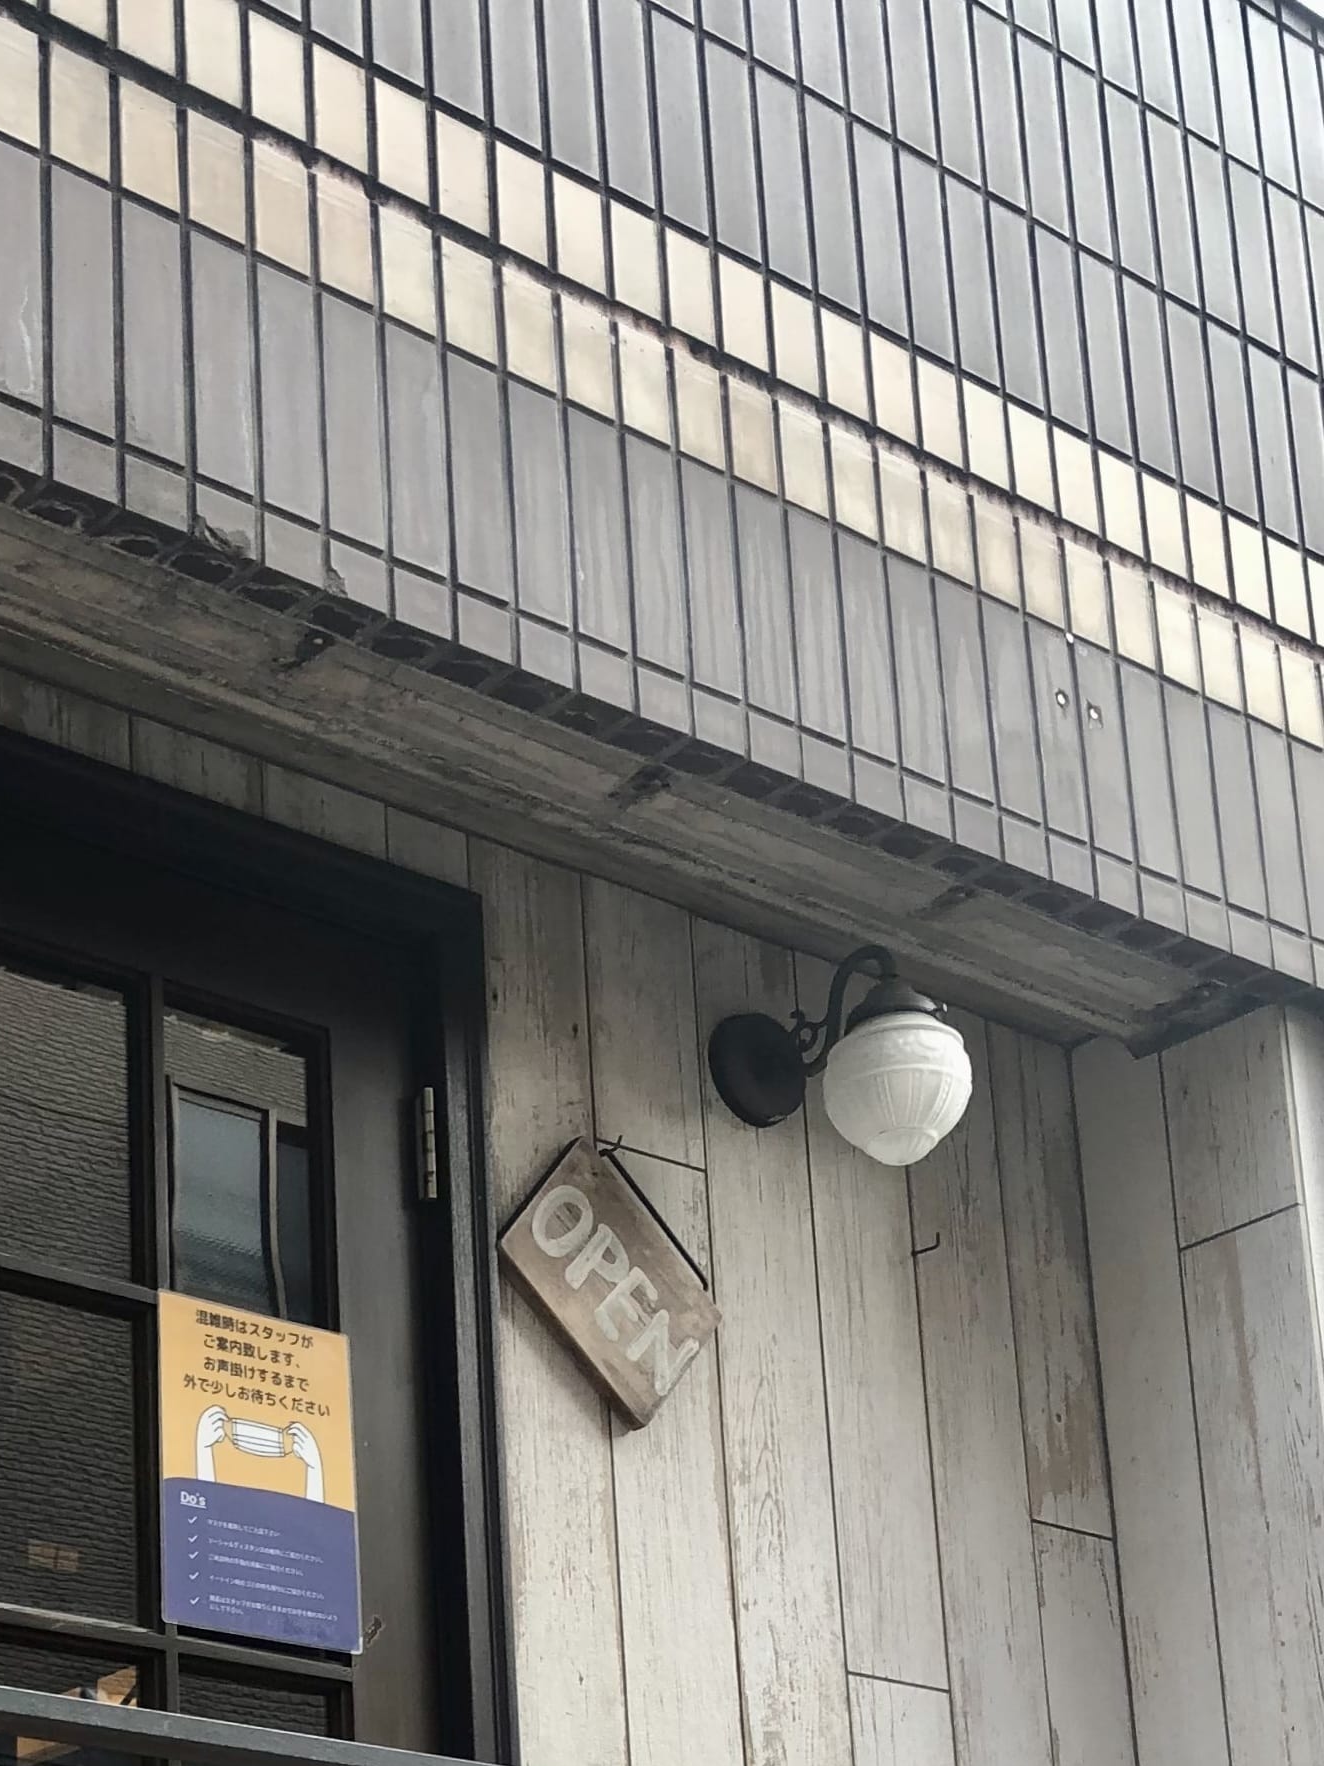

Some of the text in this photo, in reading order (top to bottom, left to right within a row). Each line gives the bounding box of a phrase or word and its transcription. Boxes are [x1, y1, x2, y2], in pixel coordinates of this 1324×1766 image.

[532, 1185, 699, 1396] OPEN
[196, 1309, 313, 1349] 混雑時はスタッフが
[204, 1356, 310, 1392] お声掛けするまで
[183, 1373, 331, 1416] 外で少しお待ちください
[180, 1491, 206, 1507] Do's
